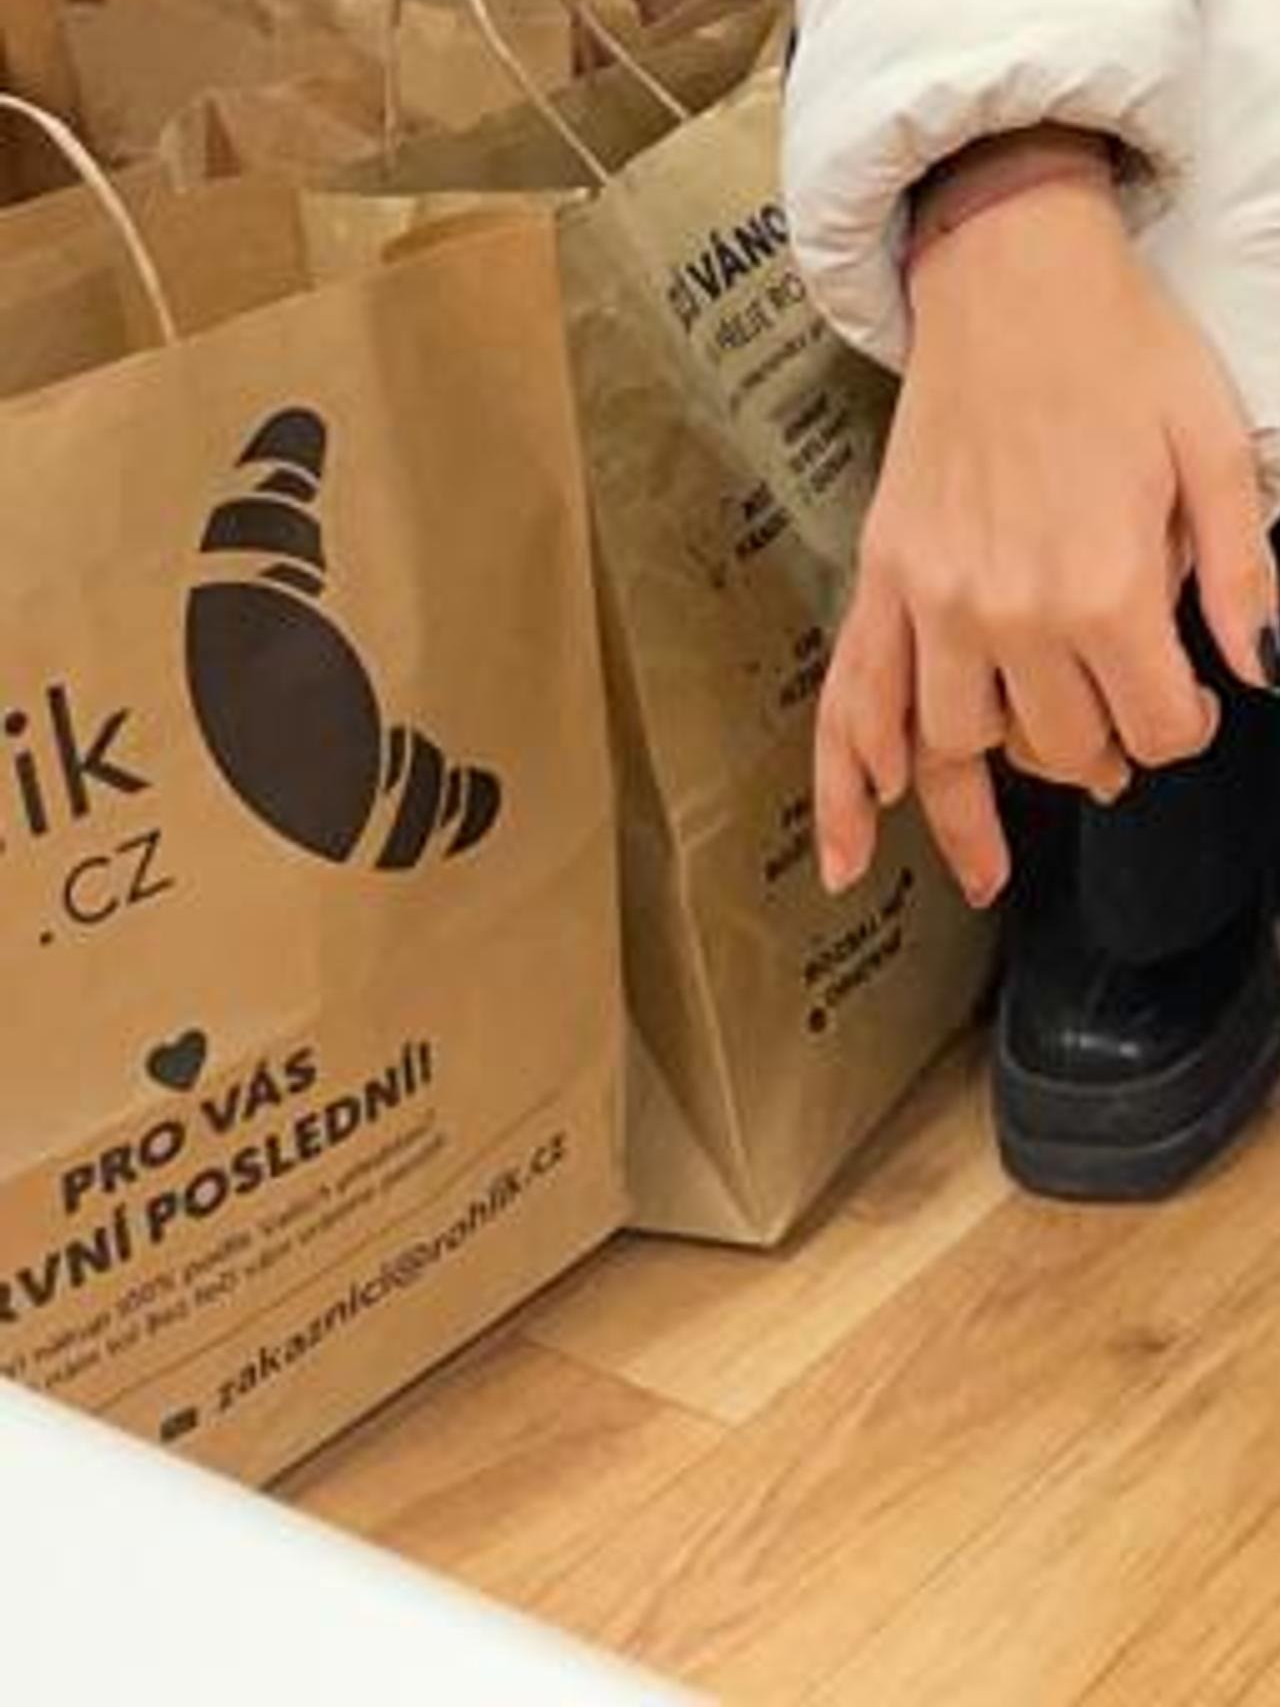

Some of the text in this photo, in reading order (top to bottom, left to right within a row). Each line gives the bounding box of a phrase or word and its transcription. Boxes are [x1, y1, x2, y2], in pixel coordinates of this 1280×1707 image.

[686, 203, 788, 303] VÁNO
[0, 685, 152, 849] ik
[39, 828, 175, 947] .CZ
[60, 1118, 187, 1214] PRO
[200, 1047, 318, 1134] VÁS
[145, 1041, 433, 1244] POSLEDNÍ!
